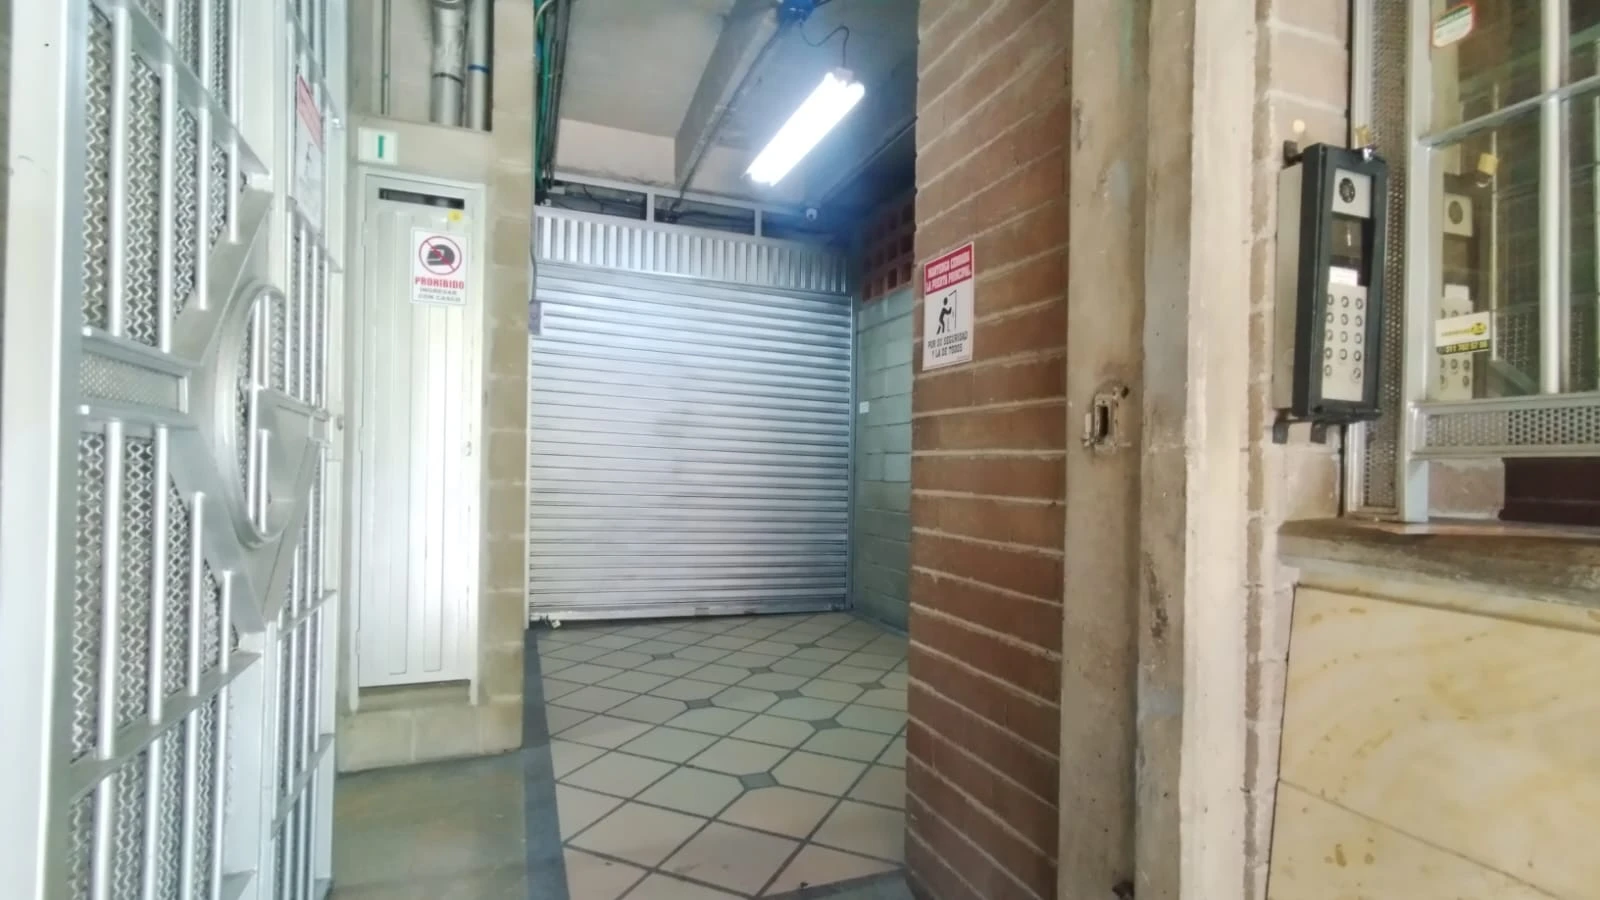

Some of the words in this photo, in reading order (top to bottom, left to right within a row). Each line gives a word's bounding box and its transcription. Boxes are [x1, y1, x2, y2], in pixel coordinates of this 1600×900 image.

[415, 276, 465, 289] PROHIBIDO
[420, 287, 457, 295] INGRESAR
[928, 339, 936, 349] POR
[937, 338, 943, 348] SU
[944, 330, 968, 346] SEGURIDAD
[935, 348, 941, 358] LA
[942, 347, 948, 356] DE
[948, 343, 963, 355] TODOS
